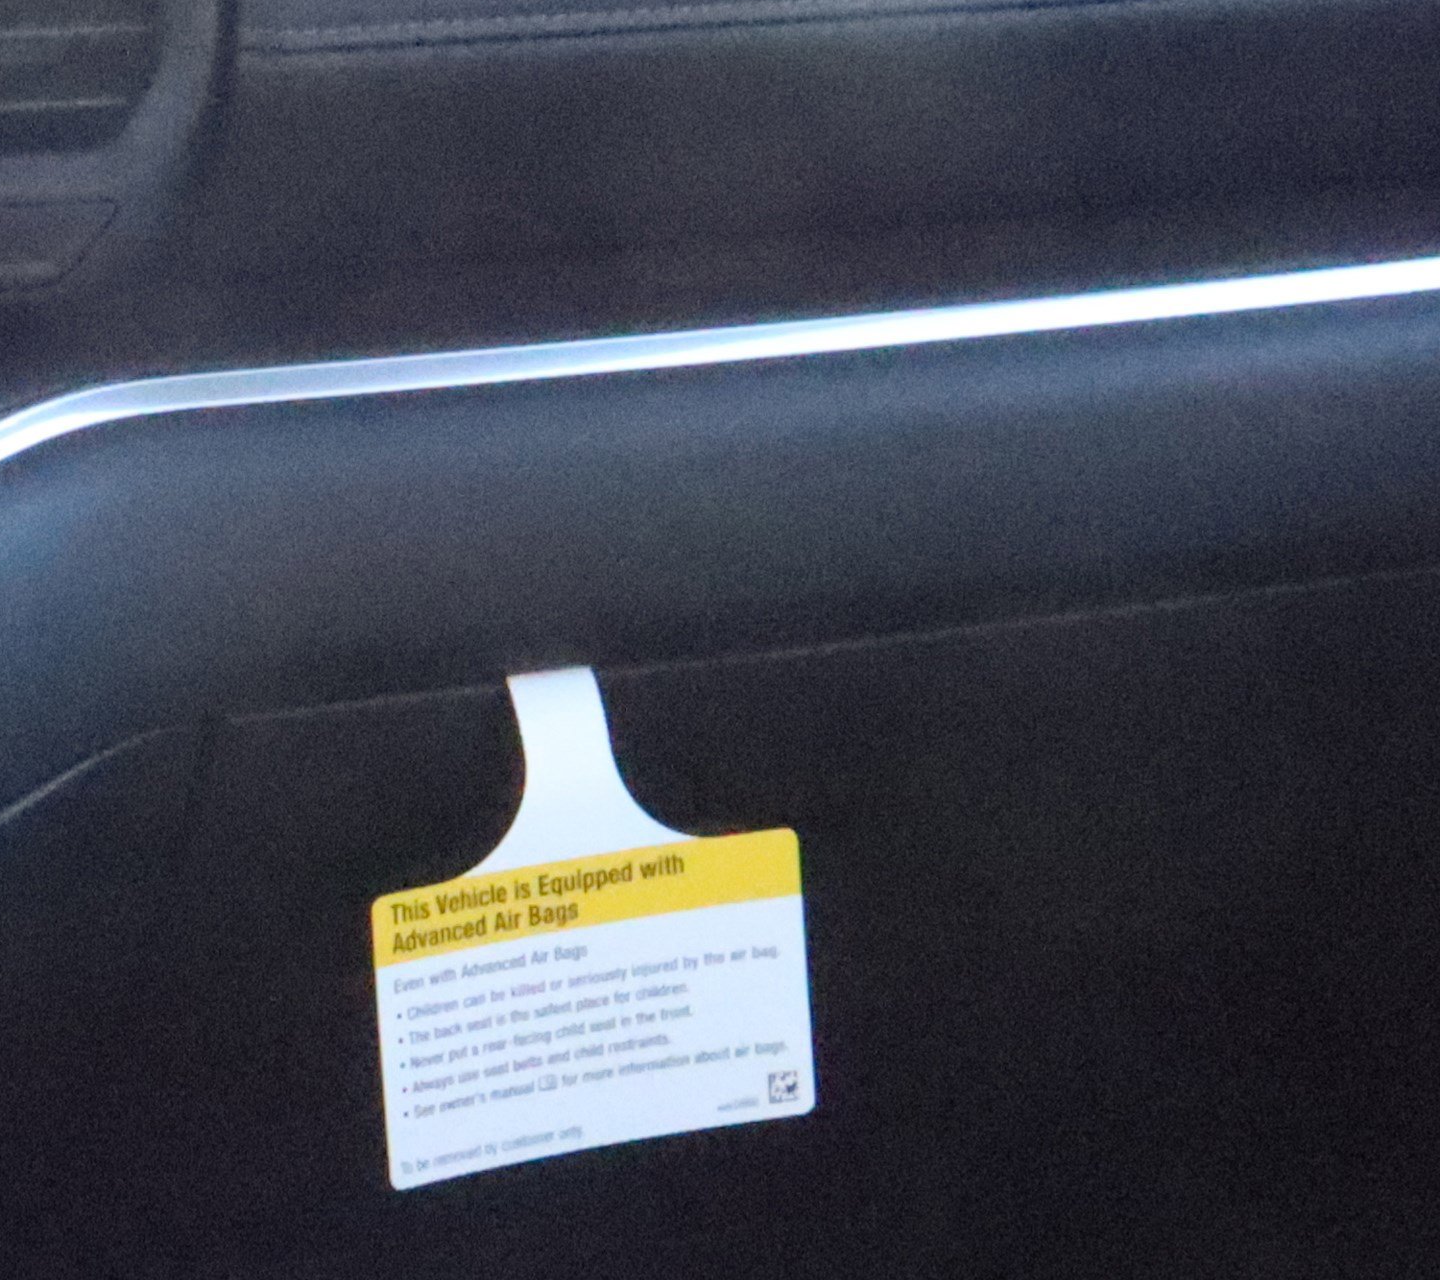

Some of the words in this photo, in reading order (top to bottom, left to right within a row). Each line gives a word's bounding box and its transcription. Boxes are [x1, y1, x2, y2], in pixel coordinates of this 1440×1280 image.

[390, 902, 431, 926] This
[436, 884, 508, 916] Vehicle
[514, 879, 533, 900] is
[538, 862, 633, 897] Equipped
[639, 853, 685, 880] with
[392, 914, 488, 955] Advanced
[494, 910, 522, 933] Air
[528, 901, 580, 927] Bags
[394, 976, 425, 995] Even
[429, 967, 458, 986] with
[461, 953, 528, 979] Advanced
[531, 949, 549, 965] Air
[554, 945, 589, 962] Bags
[407, 999, 459, 1020] Children
[463, 993, 487, 1009] can
[490, 988, 506, 1003] be
[510, 981, 547, 999] killed
[550, 979, 563, 991] or
[568, 968, 628, 988] seriously
[683, 956, 699, 971] by
[703, 951, 726, 966] the
[730, 948, 747, 962] air
